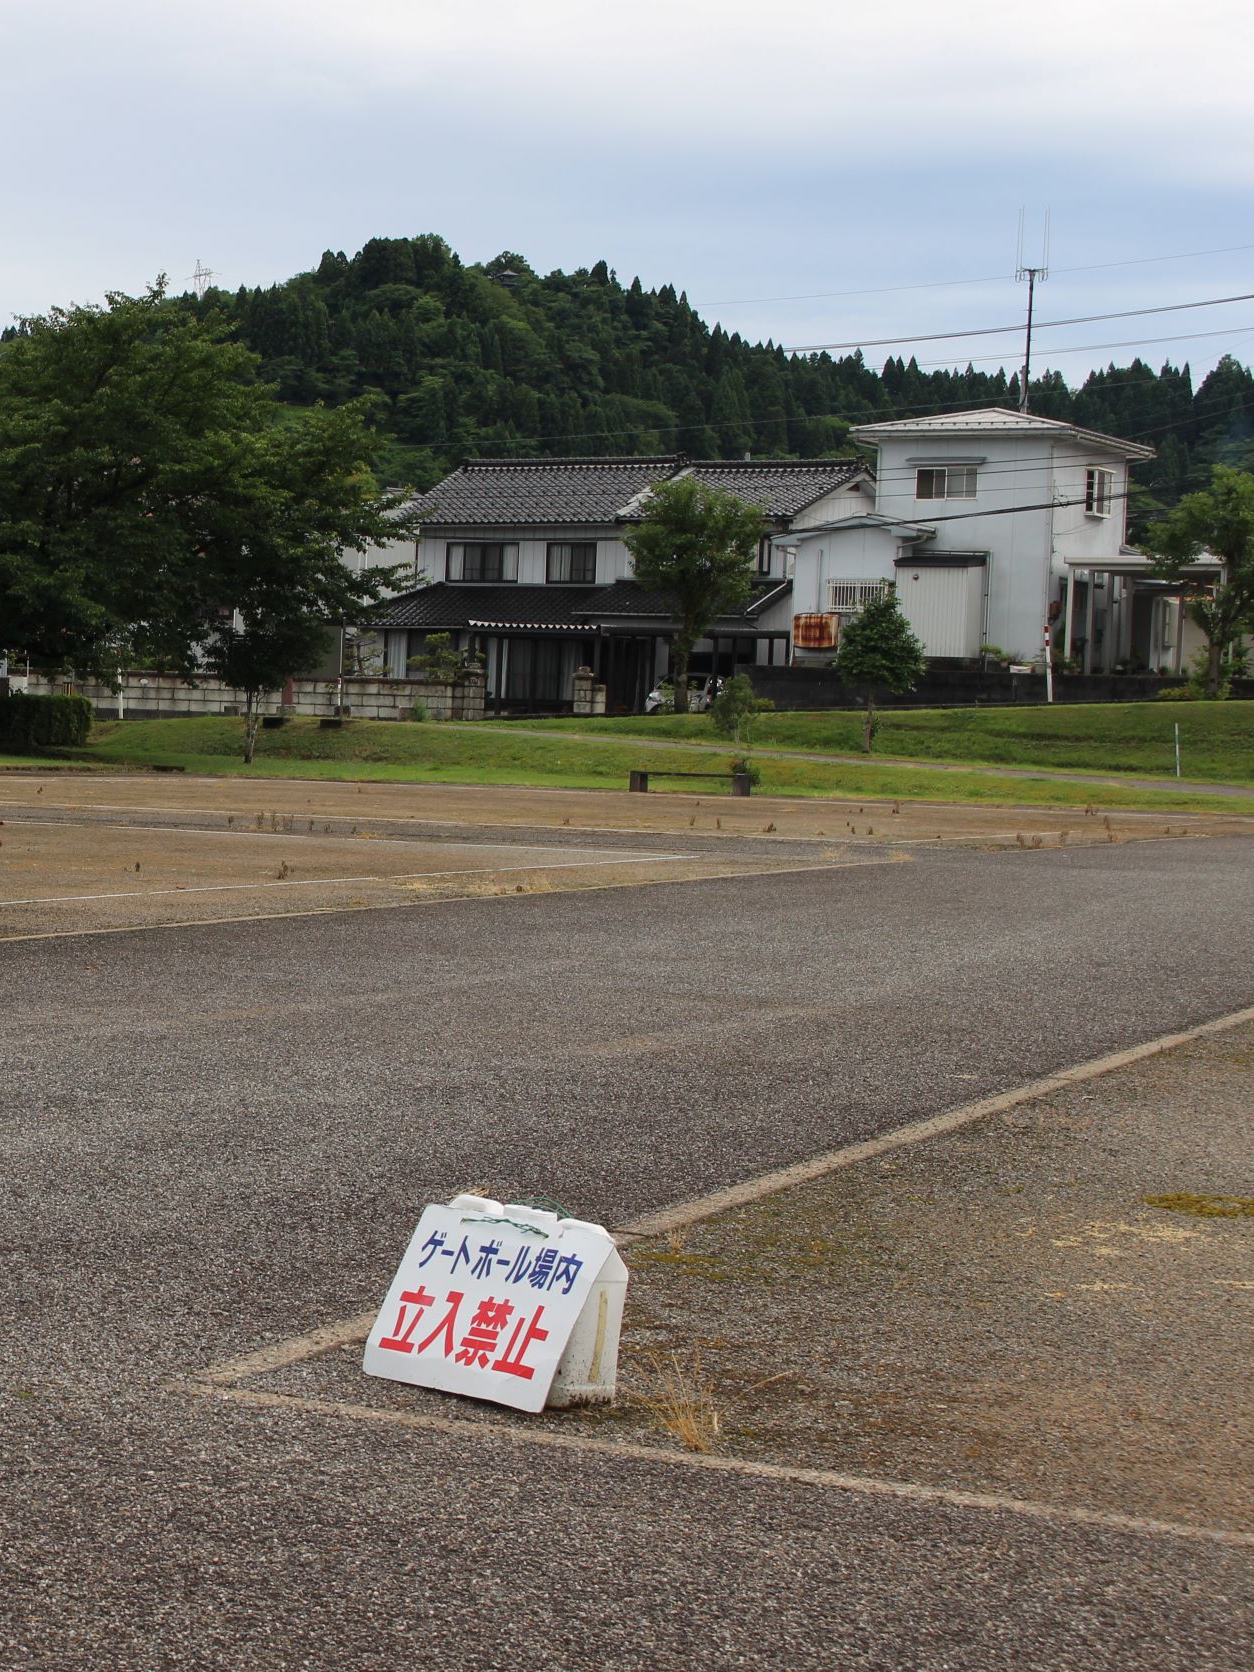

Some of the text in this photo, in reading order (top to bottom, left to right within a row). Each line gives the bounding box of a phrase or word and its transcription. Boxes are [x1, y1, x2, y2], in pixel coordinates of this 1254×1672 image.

[418, 1230, 583, 1295] ゲートボール場内
[378, 1285, 549, 1380] 立入禁止
